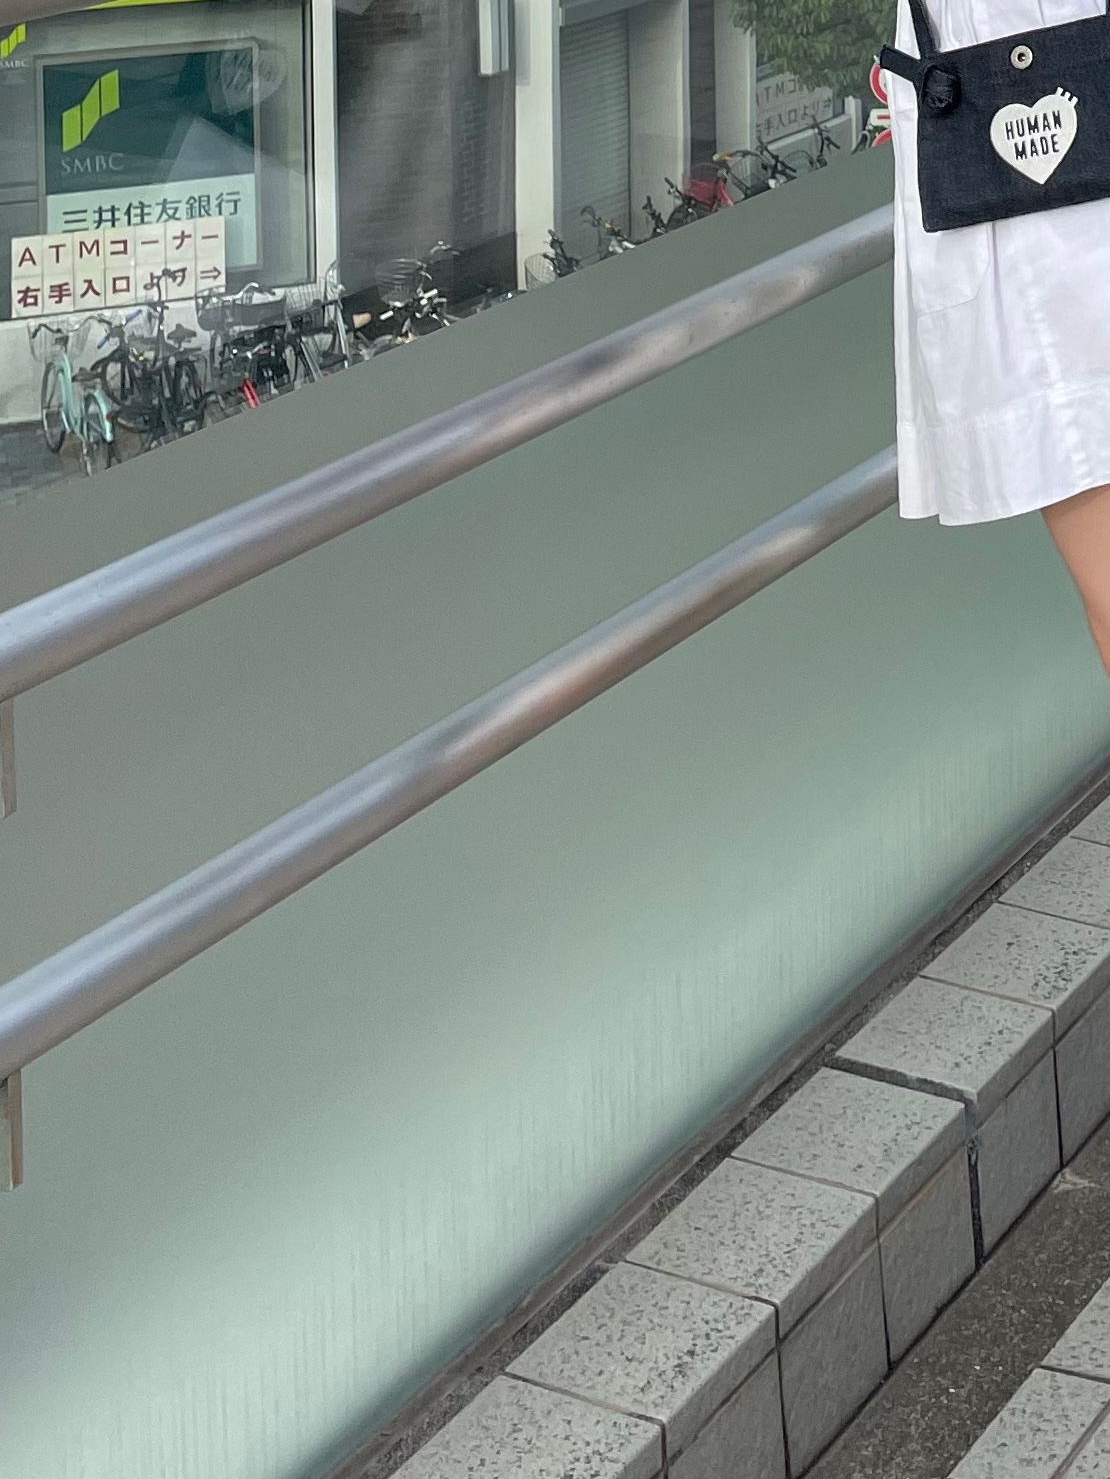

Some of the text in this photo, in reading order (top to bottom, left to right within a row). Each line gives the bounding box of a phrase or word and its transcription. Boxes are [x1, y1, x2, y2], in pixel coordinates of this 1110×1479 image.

[1005, 110, 1062, 141] HUMAN
[1014, 133, 1060, 161] MADE
[60, 153, 125, 176] SMBC
[62, 191, 242, 233] 三井住友銀行
[18, 230, 220, 267] ATMコーナー
